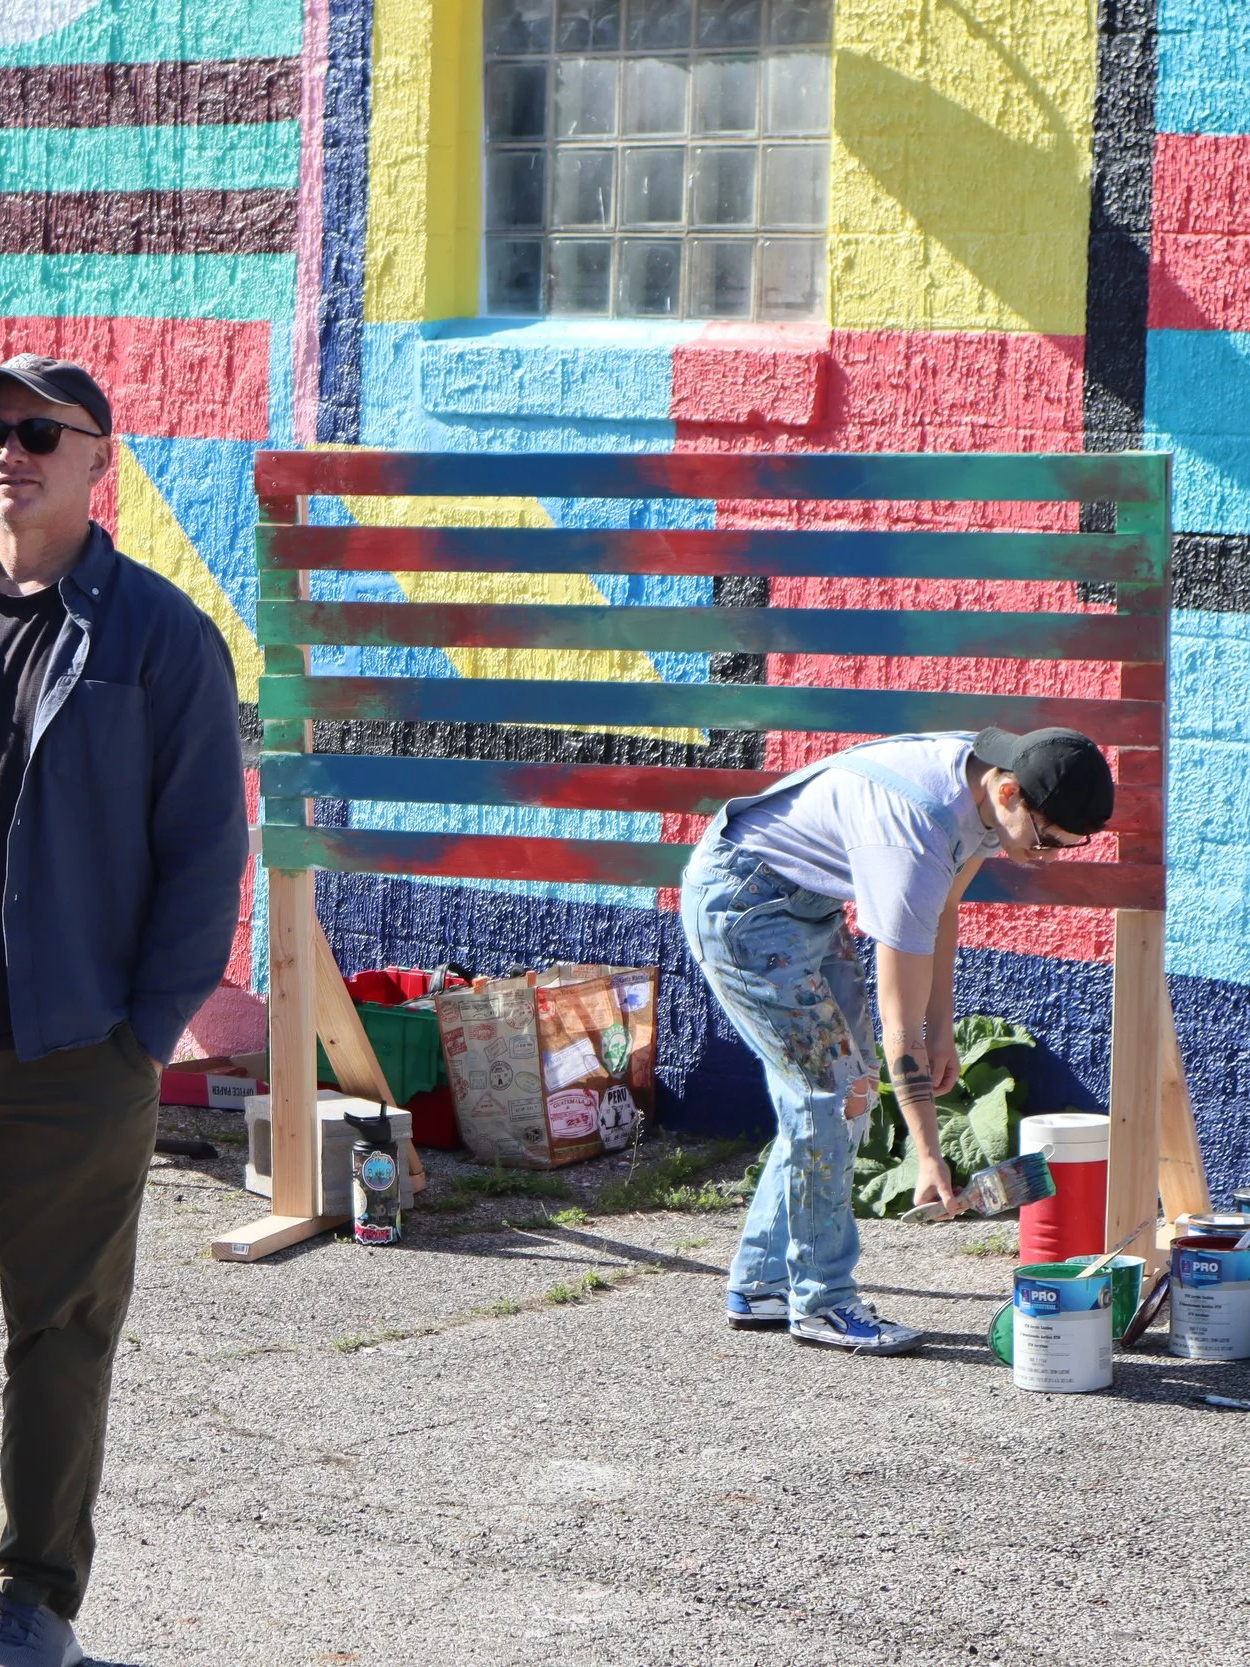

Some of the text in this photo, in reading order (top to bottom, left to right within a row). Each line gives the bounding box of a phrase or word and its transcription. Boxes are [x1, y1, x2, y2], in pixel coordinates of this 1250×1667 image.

[212, 1085, 254, 1097] OFFICE PAPER
[607, 1087, 627, 1105] PERU
[1192, 1261, 1219, 1273] PRO
[1031, 1290, 1057, 1302] PRO
